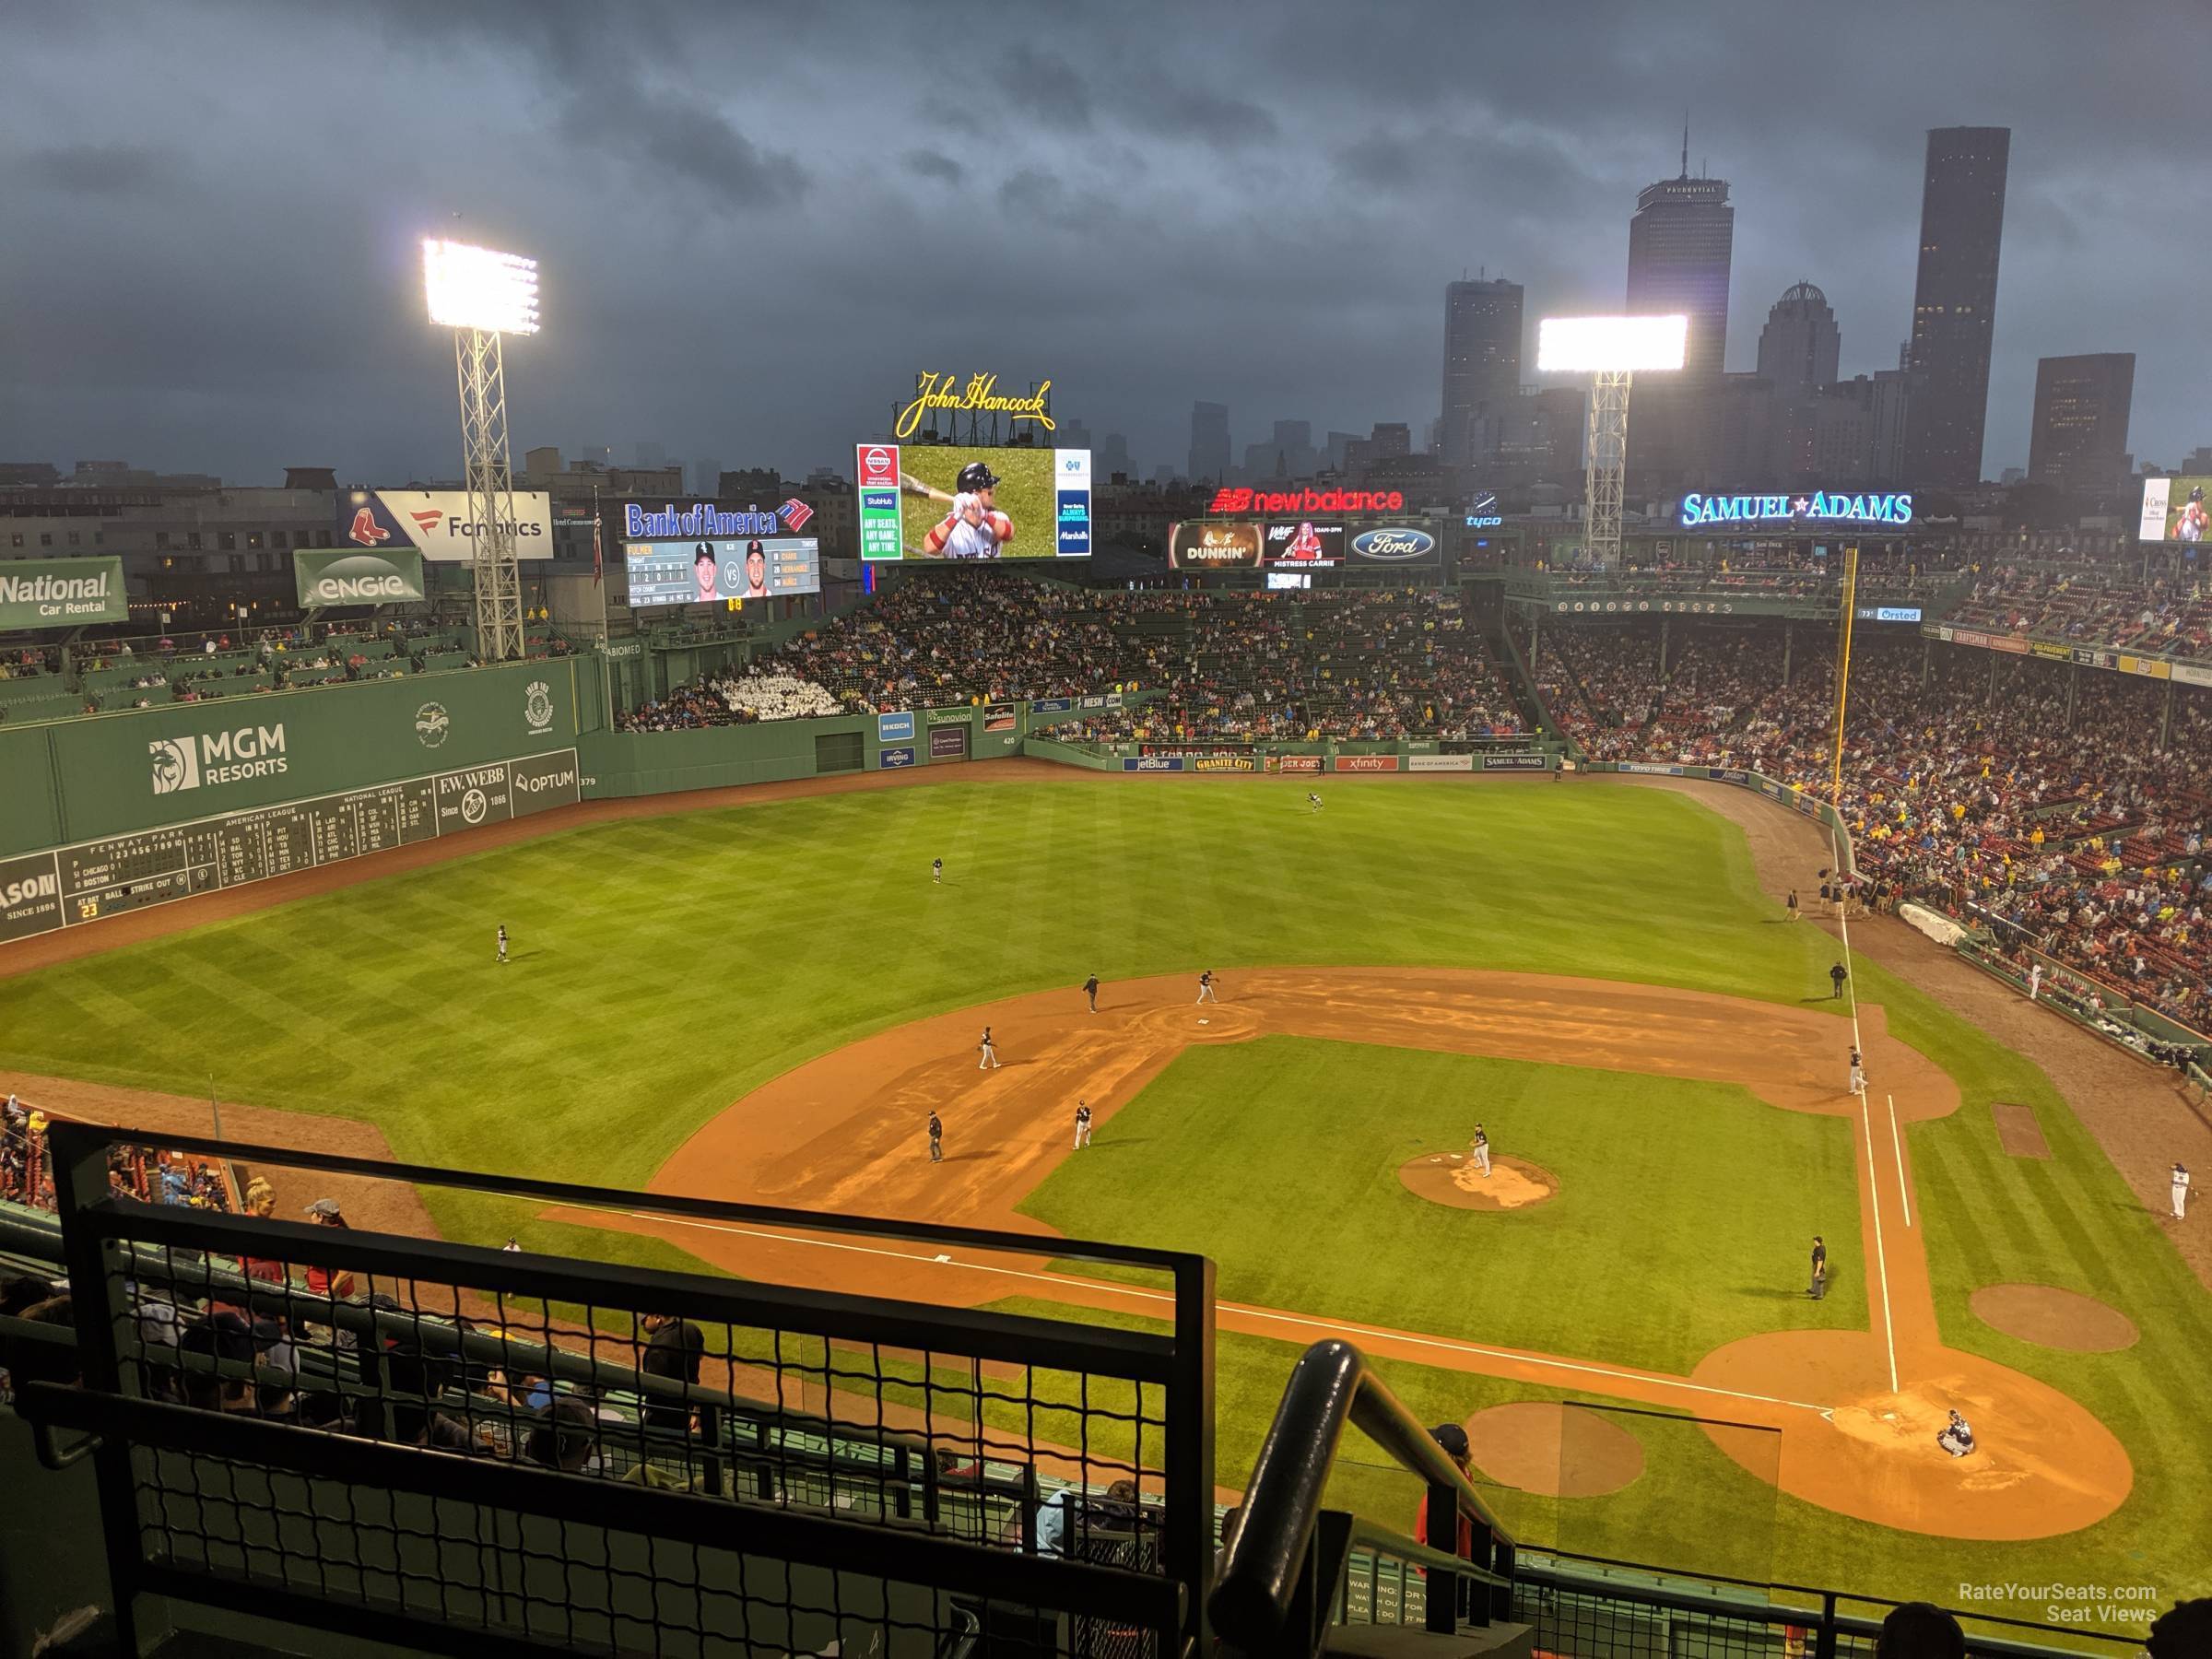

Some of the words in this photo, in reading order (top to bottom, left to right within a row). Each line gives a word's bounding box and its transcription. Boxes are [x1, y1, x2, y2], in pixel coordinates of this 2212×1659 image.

[896, 371, 960, 438] John
[960, 371, 1055, 430] Hancock
[1683, 494, 1794, 525] SAMUEL
[1806, 490, 1912, 524] ADAMS
[625, 504, 680, 537] Bank
[681, 504, 702, 536] of
[703, 504, 777, 536] America
[865, 519, 876, 529] ANY
[877, 518, 898, 529] SEATS,
[1466, 517, 1502, 529] tyco
[866, 531, 878, 540] ANY
[879, 531, 897, 541] GAME,
[1060, 531, 1088, 540] Marshalls
[868, 542, 880, 552] ANY
[881, 542, 895, 552] TIME
[1368, 533, 1418, 555] Ford
[1187, 547, 1246, 559] DUNKIN'
[727, 569, 737, 581] VS
[40, 604, 61, 616] Car
[66, 601, 105, 614] Rental
[607, 645, 640, 656] ABIOMED
[1084, 696, 1104, 708] NESN
[937, 713, 971, 723] sunovion
[202, 724, 286, 765] MGM
[887, 754, 908, 762] IRVING
[1197, 759, 1233, 769] GRANITE
[1234, 759, 1253, 769] CITY
[1350, 757, 1384, 770] xfinity
[1486, 757, 1514, 765] SAMUEL
[1516, 757, 1542, 766] ADAMS
[1137, 759, 1170, 770] jetBlue
[206, 757, 288, 785] RESORTS
[466, 768, 504, 787] WEBB
[530, 771, 574, 792] OPTUM
[580, 778, 596, 786] 379
[344, 793, 376, 803] NATIONAL
[379, 786, 403, 796] LEAGUE
[490, 794, 506, 806] 1866
[226, 814, 265, 826] AMERICAN
[268, 808, 296, 818] LEAGUE
[441, 806, 458, 818] Since
[90, 838, 142, 854] FENWAY
[152, 830, 184, 841] PARK
[230, 844, 243, 852] BAL
[232, 851, 243, 860] TOR
[82, 865, 108, 877] CHICAGO
[234, 873, 246, 881] CLE
[84, 875, 109, 887] BOSTON
[105, 889, 123, 900] BALL
[131, 883, 154, 894] STRIKE
[157, 878, 171, 888] OUT
[78, 898, 86, 906] AT
[7, 907, 34, 920] SINCE
[36, 902, 55, 914] 1898
[81, 904, 97, 918] 23
